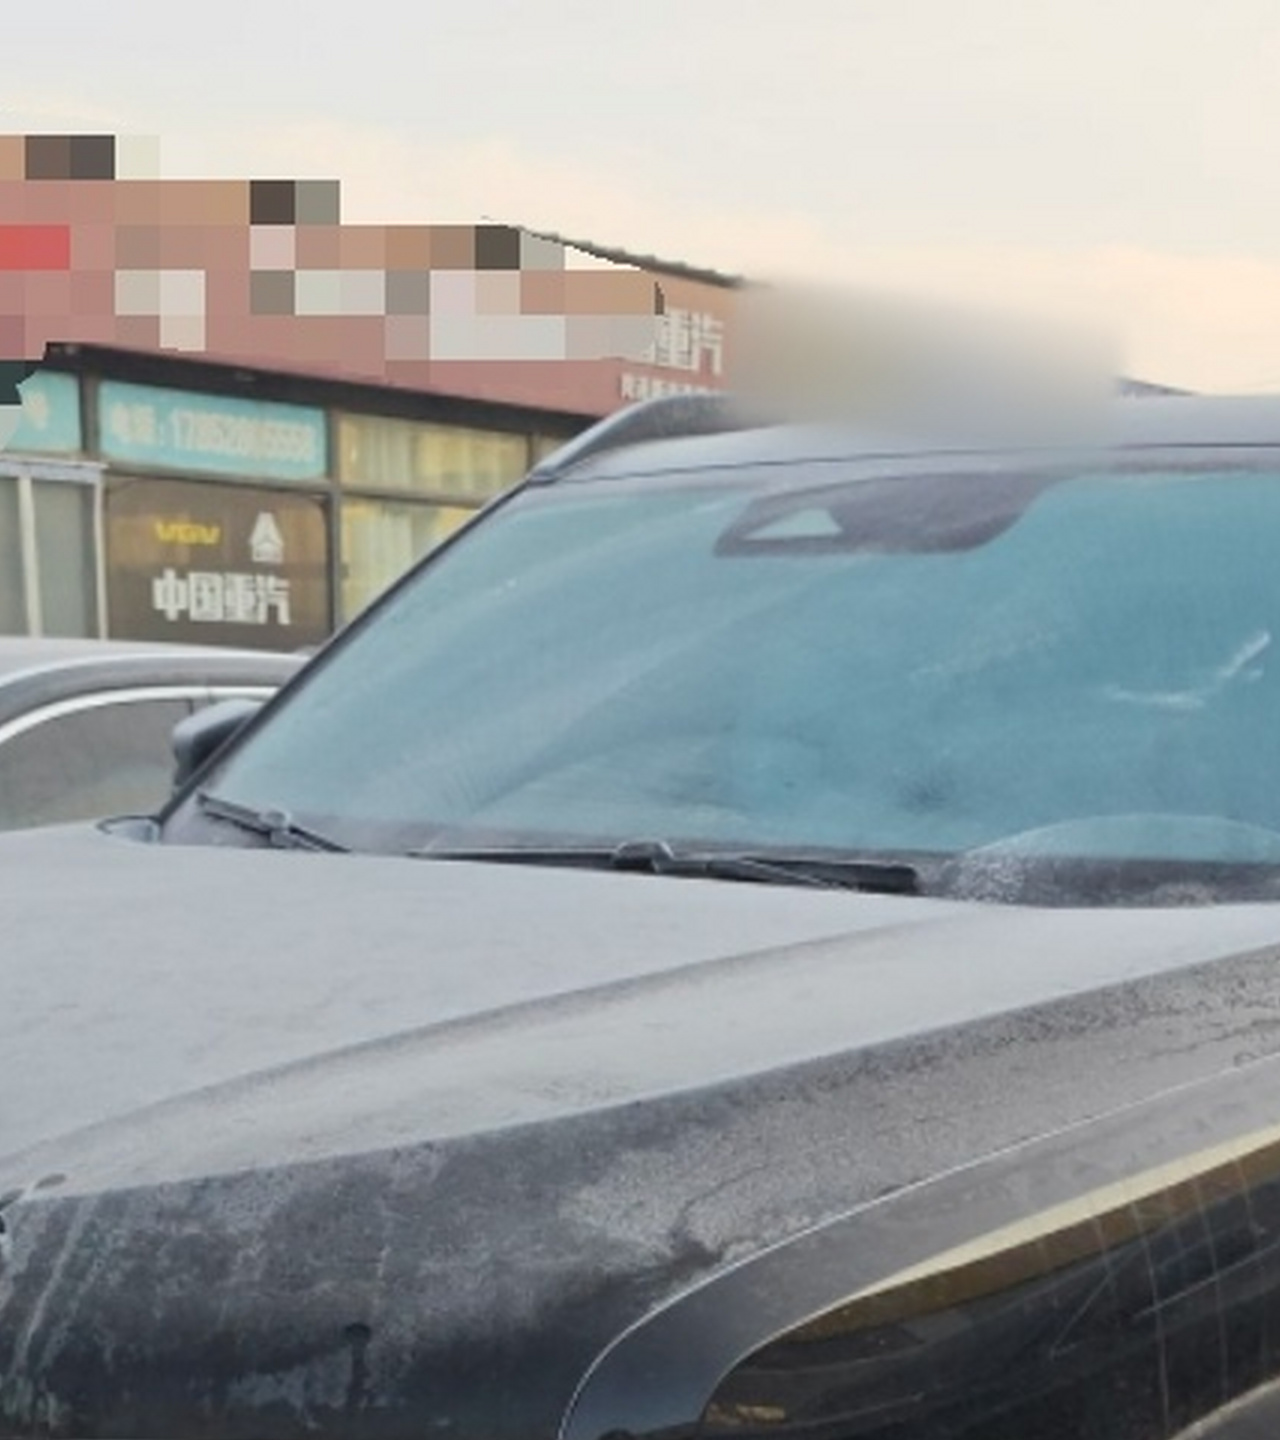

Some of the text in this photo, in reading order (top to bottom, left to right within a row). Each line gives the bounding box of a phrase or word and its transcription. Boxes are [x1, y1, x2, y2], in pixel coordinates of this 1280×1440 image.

[642, 308, 723, 376] 重汽
[152, 567, 291, 626] 中国重汽
